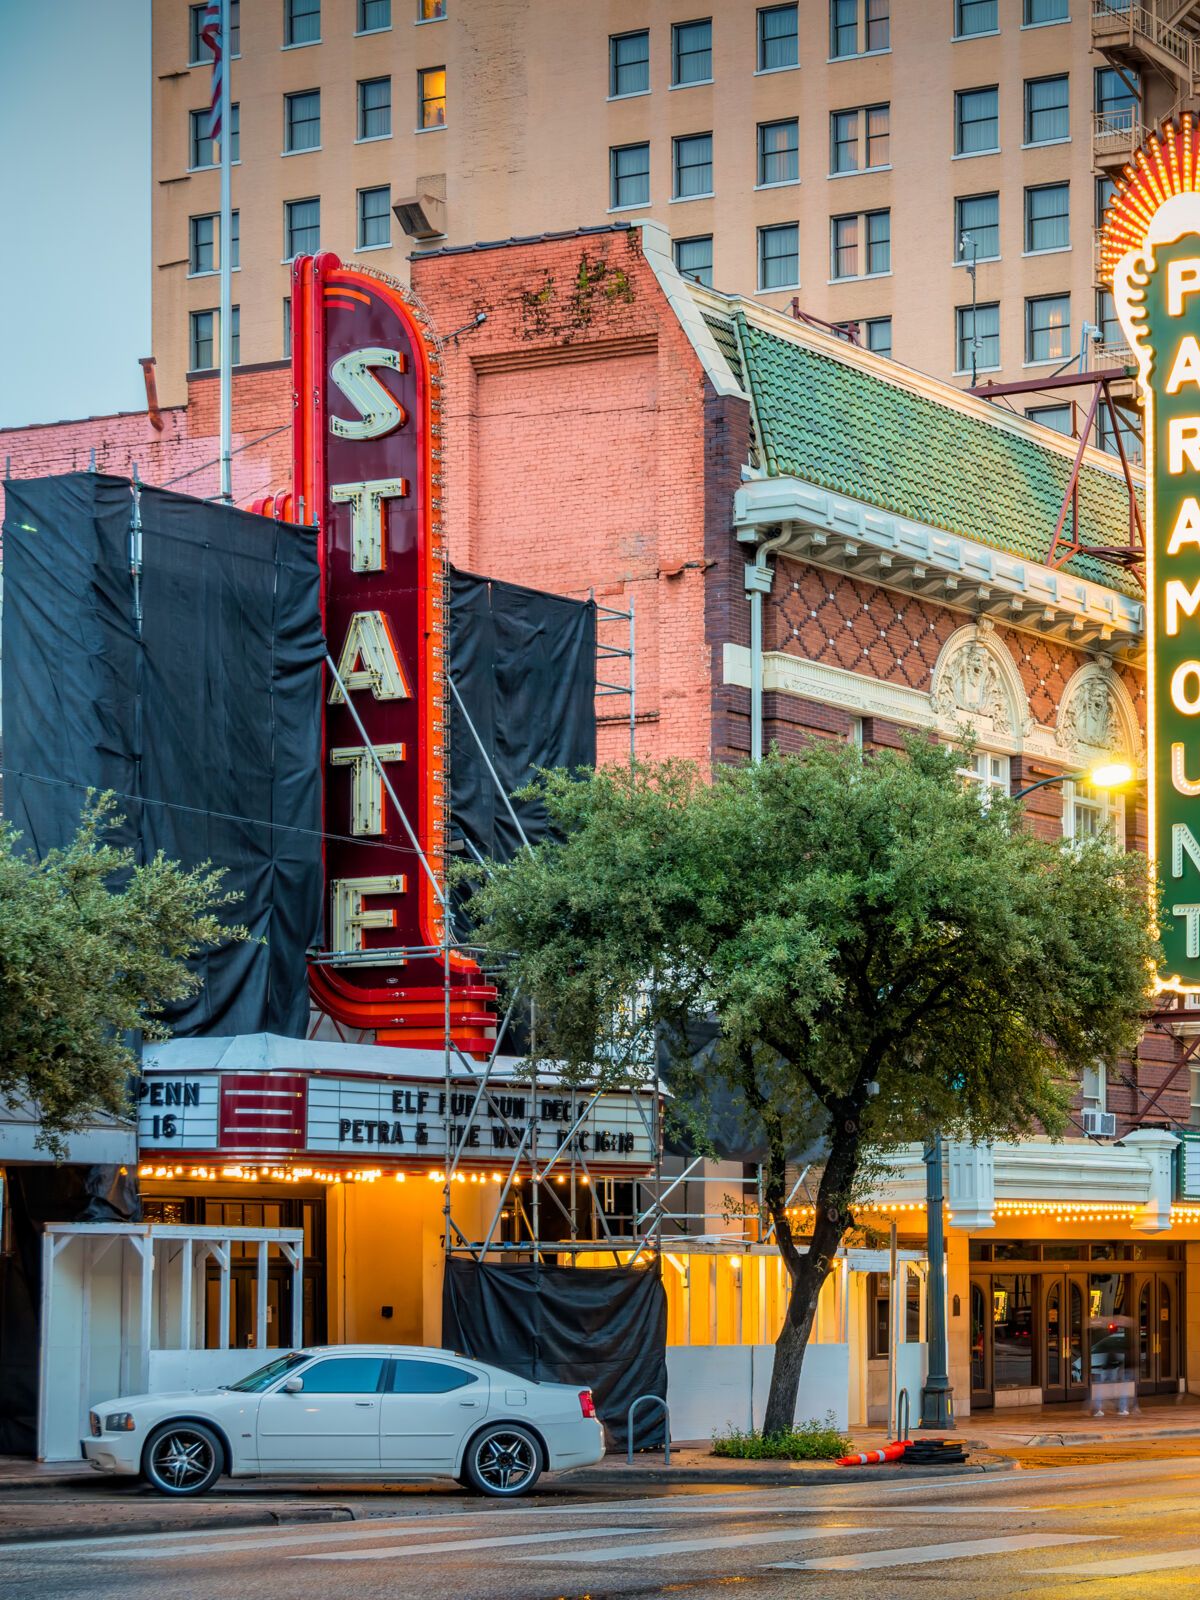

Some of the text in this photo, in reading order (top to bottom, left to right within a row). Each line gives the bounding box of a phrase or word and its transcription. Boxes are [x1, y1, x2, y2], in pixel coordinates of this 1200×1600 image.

[328, 347, 412, 969] STATE
[392, 1090, 429, 1114] ELF
[487, 1095, 525, 1119] RUN
[541, 1099, 573, 1122] DEC
[152, 1114, 177, 1139] 16
[339, 1118, 404, 1144] PETRA
[415, 1123, 428, 1145] &
[444, 1124, 480, 1148] THE
